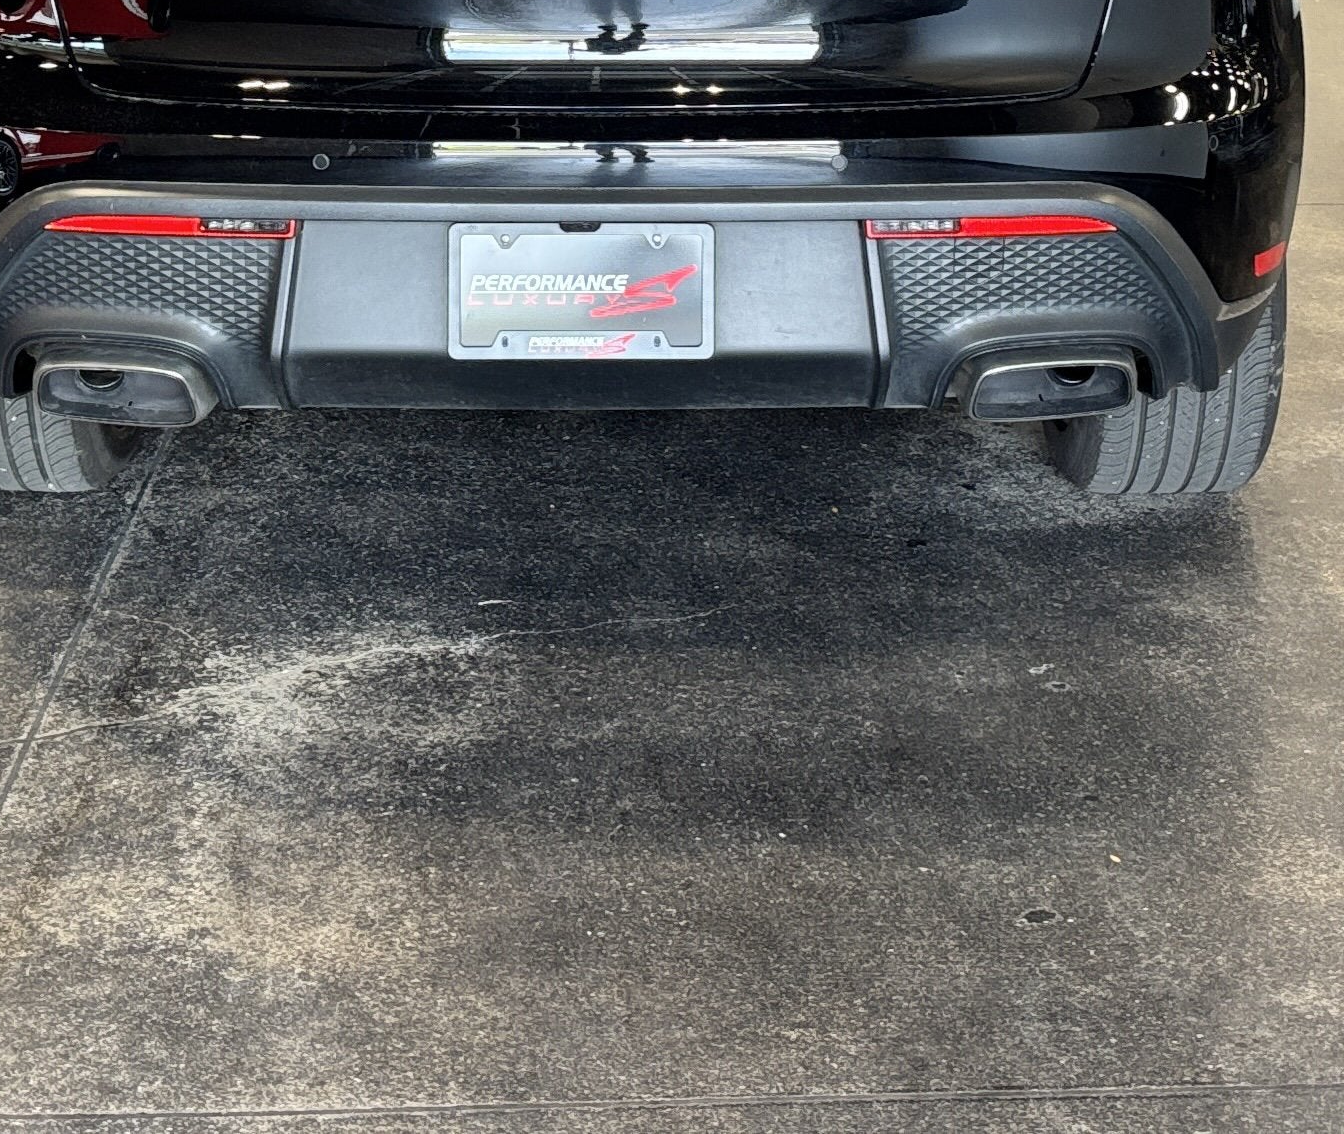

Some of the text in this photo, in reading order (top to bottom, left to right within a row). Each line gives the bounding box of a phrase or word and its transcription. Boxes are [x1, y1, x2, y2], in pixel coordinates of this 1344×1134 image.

[470, 274, 630, 292] PERFORMANCE
[467, 293, 623, 307] LUXURY
[528, 336, 605, 347] PERFORMANCE
